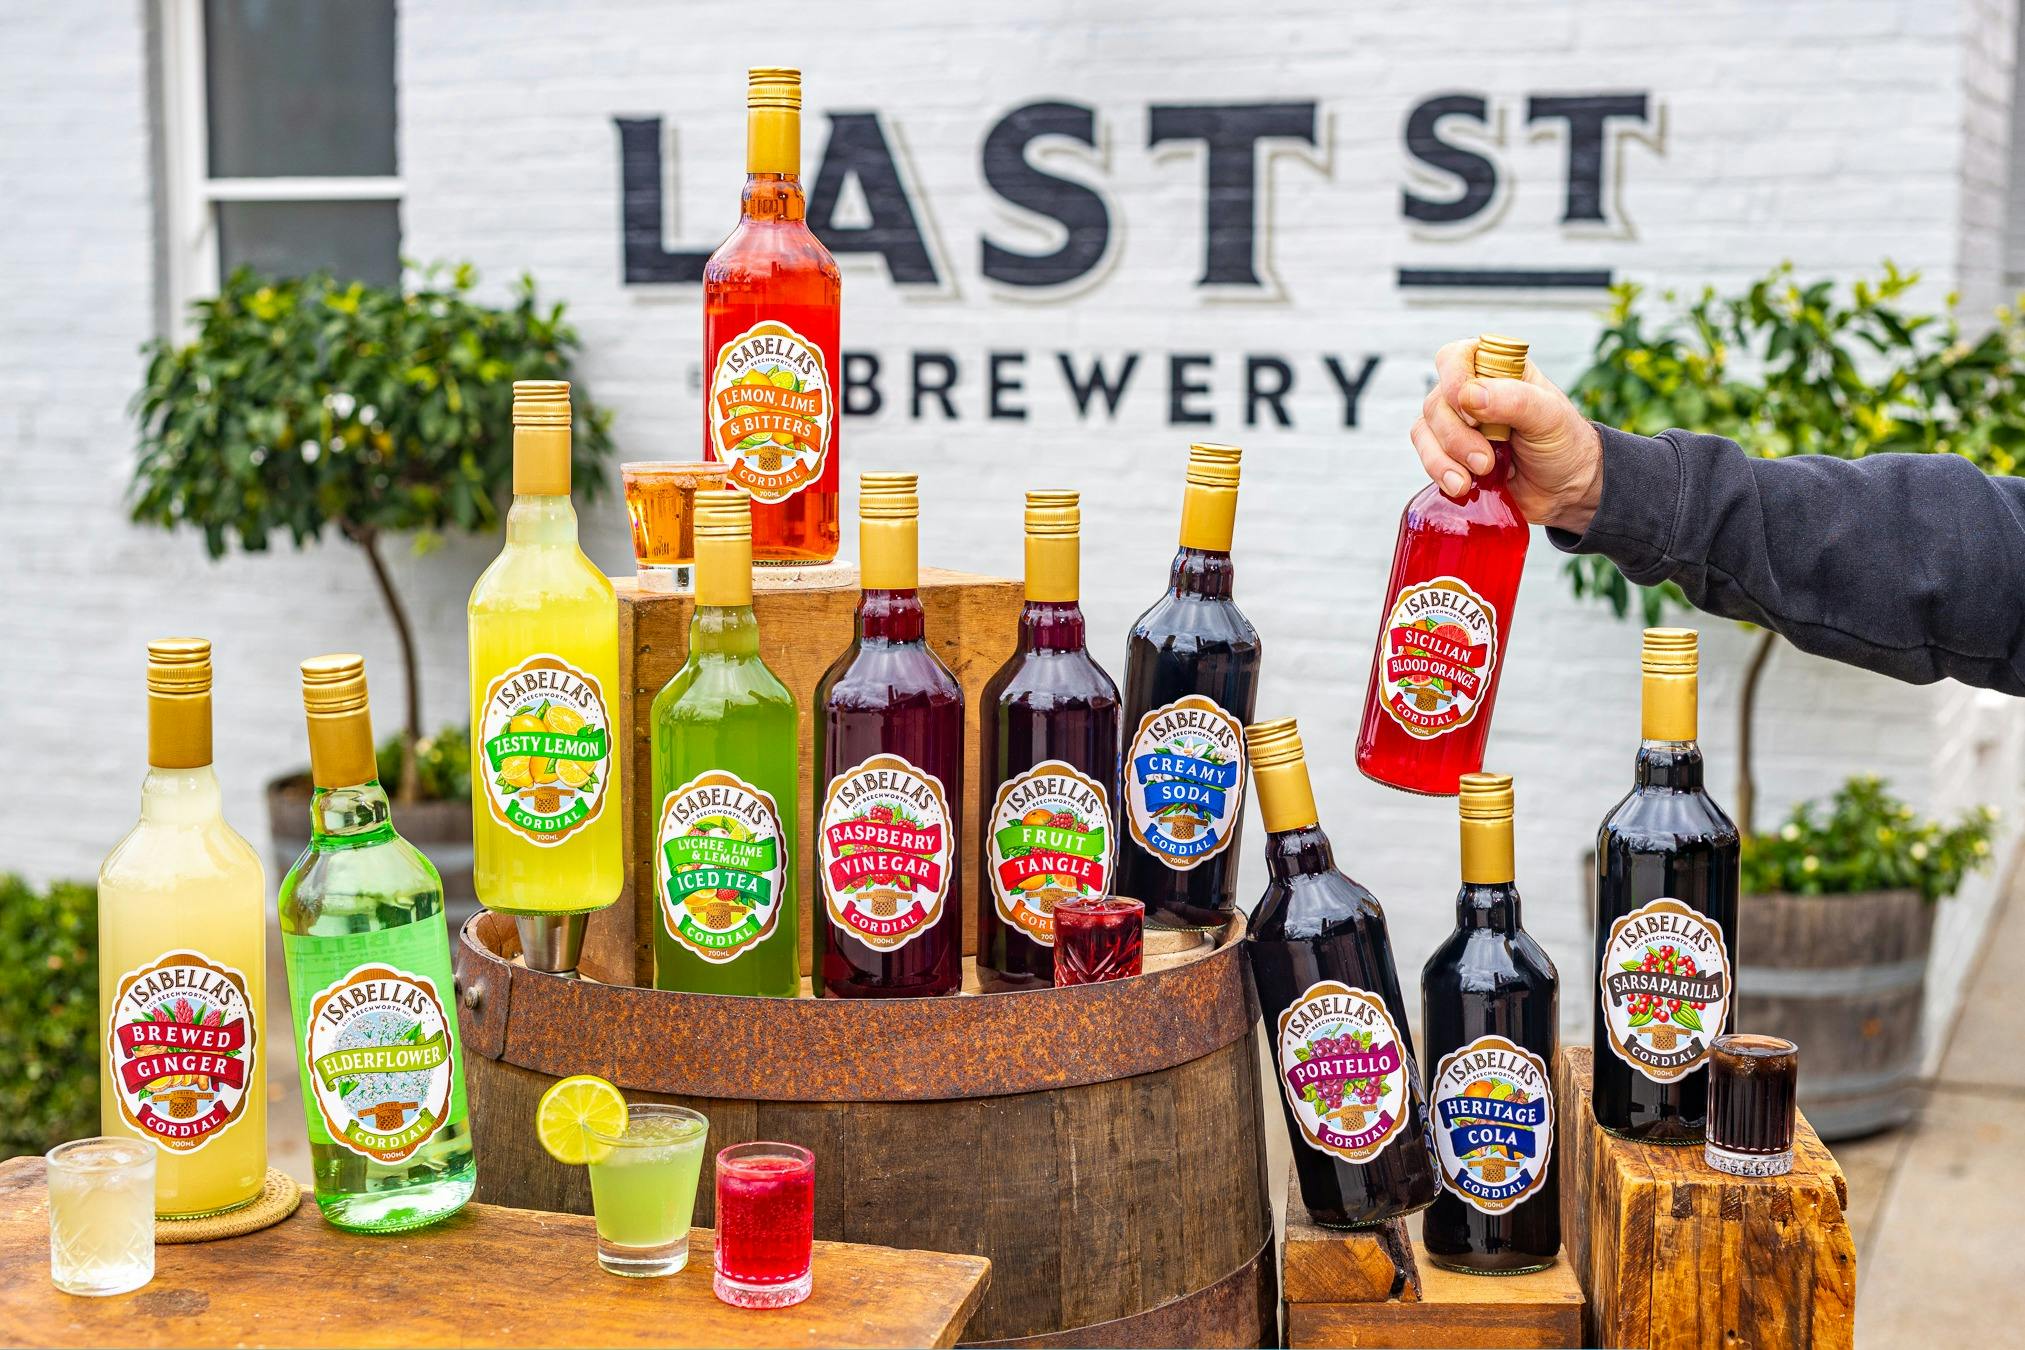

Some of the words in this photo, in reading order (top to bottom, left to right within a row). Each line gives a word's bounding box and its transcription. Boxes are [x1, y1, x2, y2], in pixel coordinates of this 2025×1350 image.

[612, 98, 1324, 300] LAST
[1402, 92, 1658, 232] ST
[727, 338, 815, 374] ISABELLA'S
[751, 358, 792, 368] BEECHWORTH
[842, 352, 1383, 427] BREWERY
[782, 394, 816, 412] LIME
[731, 422, 740, 435] &
[745, 416, 811, 437] BITTERS
[739, 470, 801, 486] CORDIAL
[1405, 591, 1486, 630] ISABELLA'S
[1425, 610, 1464, 622] BEECHWORTH
[1405, 630, 1472, 663] SICILIAN
[1392, 659, 1429, 672] BLOOD
[1430, 661, 1476, 689] ORANGE
[497, 672, 593, 709] ISABELLA'S
[523, 692, 568, 702] BEECHWORTH
[1397, 704, 1452, 726] CORDIAL
[1149, 712, 1235, 748] ISABELLA'S
[1172, 730, 1213, 741] BEECHWORTH
[494, 736, 543, 756] ZESTY
[545, 736, 599, 757] LEMON
[1149, 758, 1226, 784] CREAMY
[837, 772, 933, 810] ISABELLA'S
[863, 793, 908, 803] BEECHWORTH
[1007, 779, 1098, 813] ISABELLA'S
[1163, 786, 1210, 803] SODA
[672, 789, 767, 825] ISABELLA'S
[696, 809, 741, 819] BEECHWORTH
[1032, 799, 1075, 808] BEECHWORTH
[515, 812, 581, 829] CORDIAL
[832, 824, 935, 849] RASPBERRY
[1023, 828, 1086, 850] FRUIT
[1152, 835, 1211, 854] CORDIAL
[692, 851, 701, 860] &
[704, 852, 750, 866] LEMON
[732, 845, 763, 858] LIME
[841, 855, 930, 877] VINEGAR
[1015, 858, 1092, 876] TANGLE
[677, 872, 719, 891] ICED
[725, 872, 758, 892] TEA
[850, 913, 918, 932] CORDIAL
[1619, 915, 1713, 951] ISABELLA'S
[687, 927, 753, 945] CORDIAL
[1644, 935, 1688, 945] BEECHWORTH
[128, 969, 235, 1007] ISABELLA'S
[157, 992, 208, 1002] BEECHWORTH
[1614, 975, 1719, 998] SARSAPARILLA
[323, 983, 428, 1026] ISABELLA'S
[352, 1005, 400, 1018] BEECHWORTH
[1288, 997, 1377, 1039] ISABELLA'S
[1312, 1017, 1354, 1031] BEECHWORTH
[132, 1026, 230, 1047] BREWED
[323, 1046, 441, 1075] ELDERFLOWER
[1632, 1046, 1696, 1065] CORDIAL
[138, 1056, 227, 1077] GINGER
[1296, 1056, 1391, 1082] PORTELLO
[1448, 1052, 1537, 1086] ISABELLA'S
[1473, 1071, 1515, 1080] BEECHWORTH
[1447, 1101, 1537, 1123] HERITAGE
[147, 1118, 220, 1136] CORDIAL
[355, 1125, 427, 1148] CORDIAL
[1325, 1125, 1388, 1147] CORDIAL
[1468, 1129, 1518, 1145] COLA
[1463, 1180, 1526, 1197] CORDIAL
